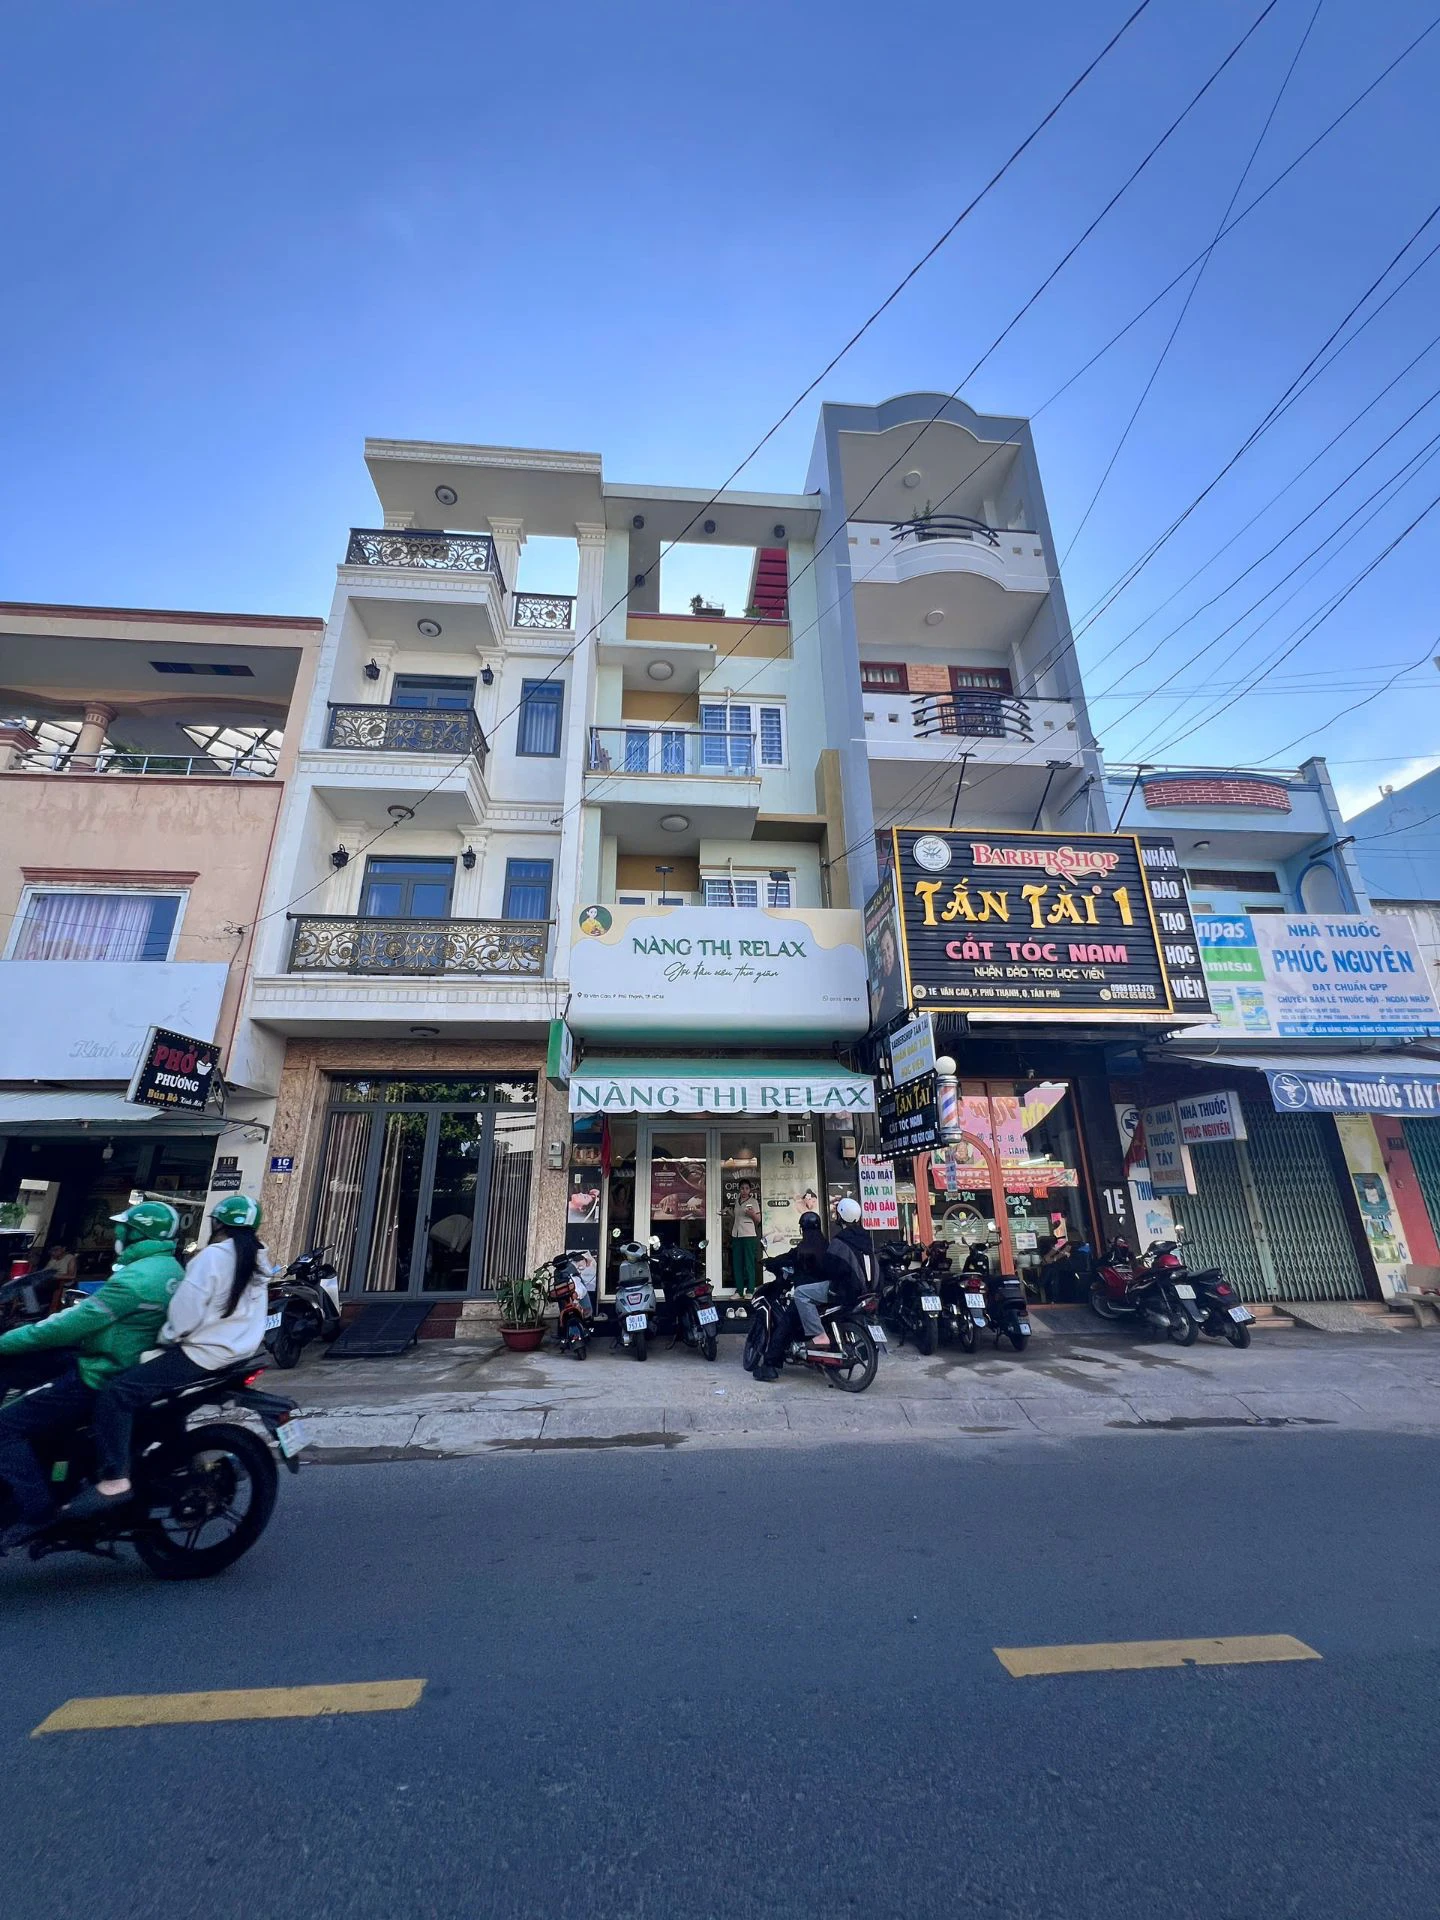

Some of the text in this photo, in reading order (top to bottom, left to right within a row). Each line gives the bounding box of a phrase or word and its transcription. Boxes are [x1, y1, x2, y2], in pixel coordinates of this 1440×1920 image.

[1142, 847, 1177, 870] NHẬN
[1151, 877, 1180, 899] ĐÀO
[914, 877, 1009, 926] TẤN
[1021, 883, 1100, 929] TÀI
[1112, 886, 1134, 926] 1
[1160, 912, 1186, 933] TẠO
[1287, 920, 1381, 938] NHÀ THUỐC
[633, 935, 807, 960] NÀNG THỊ RELAX
[946, 932, 1128, 964] CẮT TÓC NAM
[1165, 945, 1195, 968] HỌC
[1272, 944, 1415, 973] PHÚC NGUYÊN
[974, 966, 1105, 982] NHẬN ĐÀO TẠO HỌC VIÊN
[928, 987, 938, 996] 1E
[1170, 976, 1204, 998] VIÊN
[1312, 984, 1331, 993] ĐẠT
[1334, 980, 1367, 991] CHUẨN
[152, 1044, 198, 1073] PHỞ
[154, 1072, 199, 1092] PHƯƠNG
[1307, 1078, 1346, 1106] NHÀ
[1346, 1075, 1401, 1108] THUỐC
[1403, 1079, 1435, 1108] TÂY
[146, 1088, 166, 1100] Bún
[168, 1092, 178, 1102] Bò
[576, 1081, 870, 1111] NÀNG THỊ RELAX
[1180, 1095, 1227, 1120] NHÀ THUỐC
[1149, 1129, 1176, 1147] THUỐC
[1183, 1119, 1231, 1138] PHÚC NGUYÊN
[277, 1158, 290, 1166] 1C
[1156, 1150, 1173, 1166] TÂY
[861, 1170, 876, 1182] CẠO
[864, 1184, 893, 1196] RÁY TAI
[1103, 1189, 1126, 1215] 1E
[863, 1218, 880, 1227] NAM
